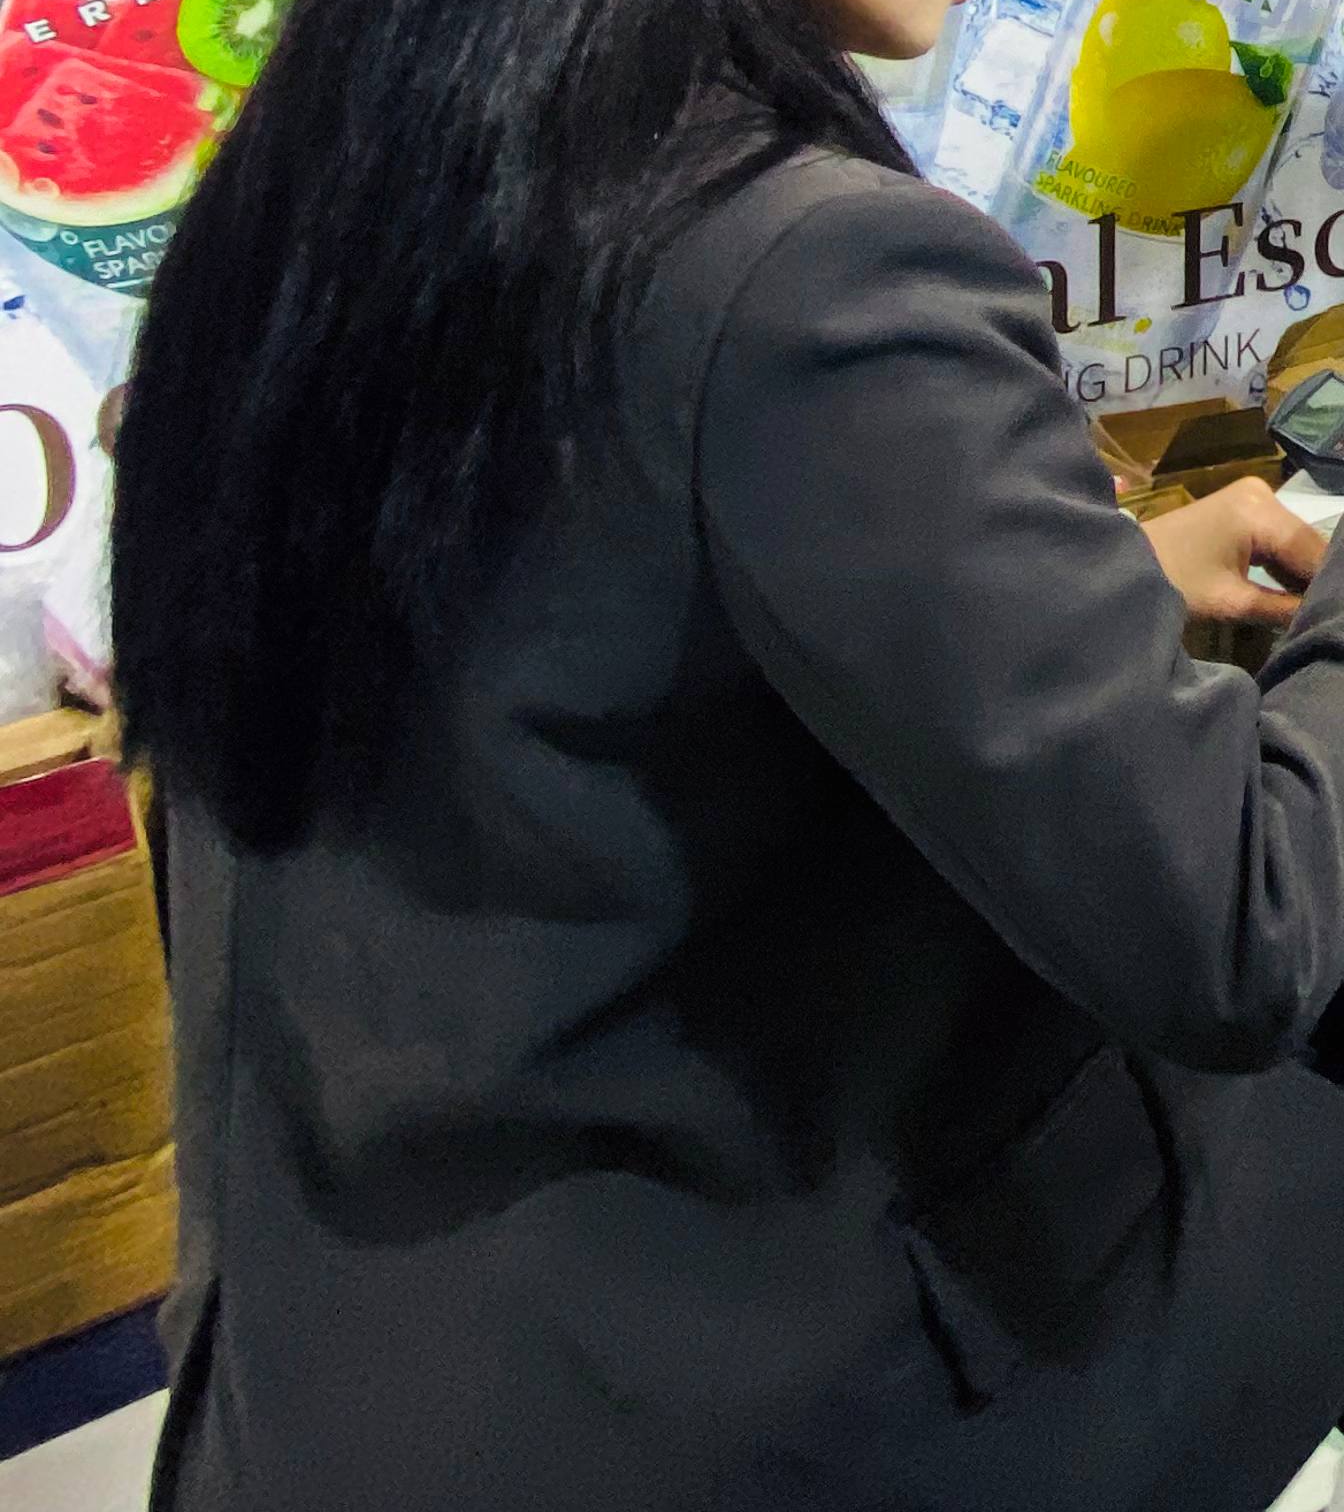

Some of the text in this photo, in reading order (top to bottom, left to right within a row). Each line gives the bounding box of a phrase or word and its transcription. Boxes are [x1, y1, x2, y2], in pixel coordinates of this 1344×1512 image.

[1046, 149, 1138, 199] FLAVOURED
[82, 221, 177, 259] FLAVO
[1124, 328, 1262, 394] DRINK
